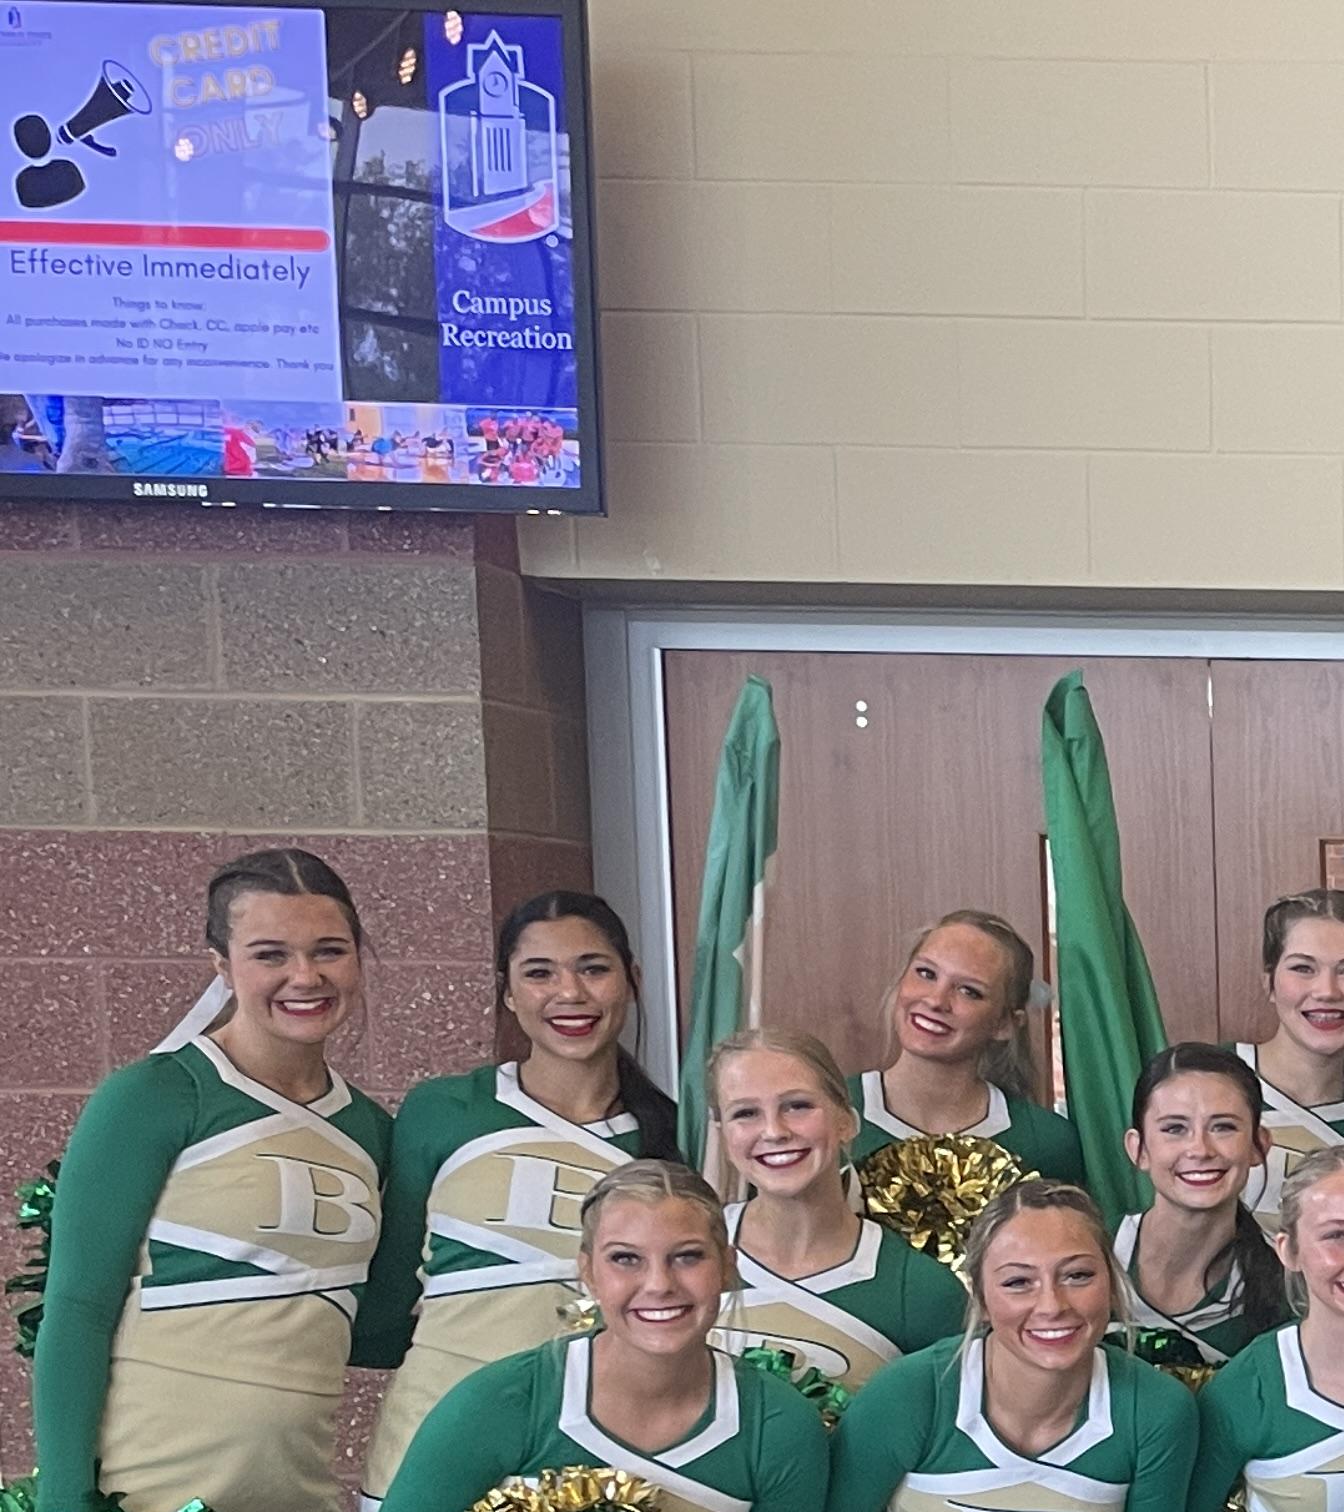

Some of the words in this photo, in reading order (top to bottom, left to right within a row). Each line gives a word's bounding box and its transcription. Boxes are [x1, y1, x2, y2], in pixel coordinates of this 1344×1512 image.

[149, 20, 281, 66] CREDIT
[171, 66, 274, 109] CARD
[176, 111, 284, 158] ONLY
[10, 249, 133, 277] Effective
[143, 254, 311, 290] Immediately
[155, 300, 168, 310] to
[452, 289, 552, 321] Campus
[6, 313, 22, 325] All
[273, 324, 295, 336] pay
[299, 323, 319, 335] etc
[441, 322, 573, 350] Recreation
[116, 337, 133, 349] No
[137, 338, 149, 349] ID
[153, 338, 173, 350] NO
[177, 338, 208, 353] Entry
[277, 358, 310, 369] Thank
[133, 482, 208, 497] SAMSUNG
[257, 1153, 375, 1245] B
